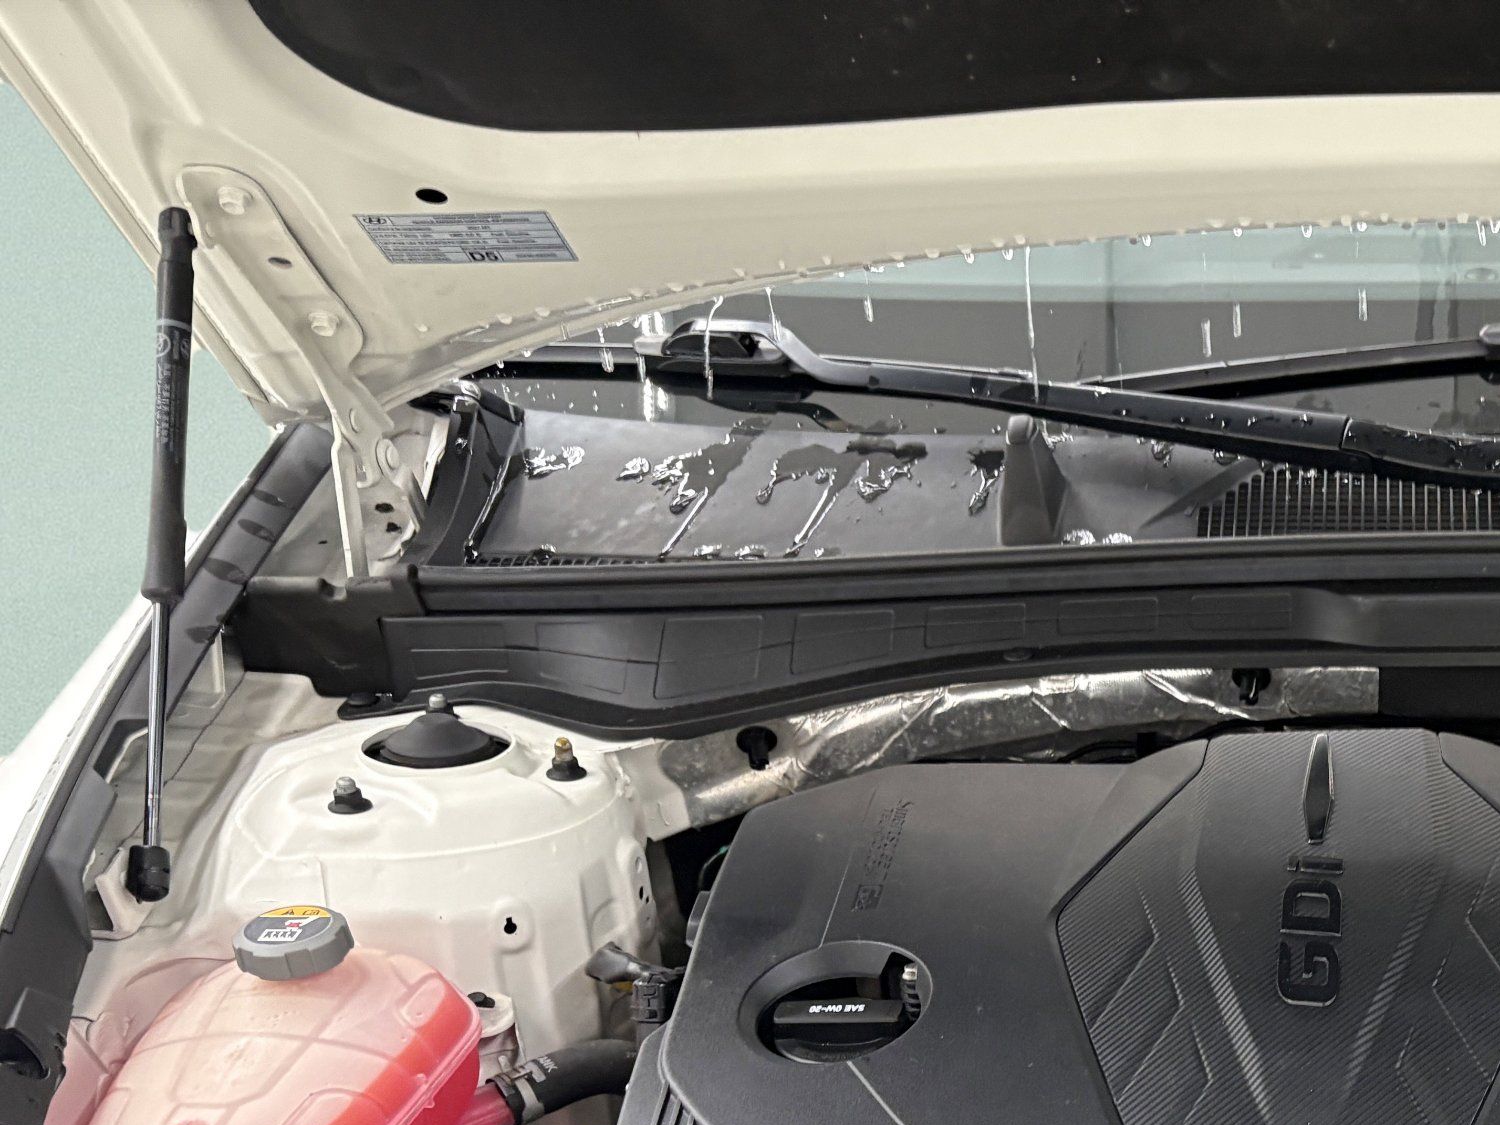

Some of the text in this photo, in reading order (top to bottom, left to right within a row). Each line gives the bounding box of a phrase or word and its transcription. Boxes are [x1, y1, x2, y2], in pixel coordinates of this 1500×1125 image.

[1277, 855, 1344, 1007] GDi
[808, 1004, 866, 1013] SAE 0W-20
